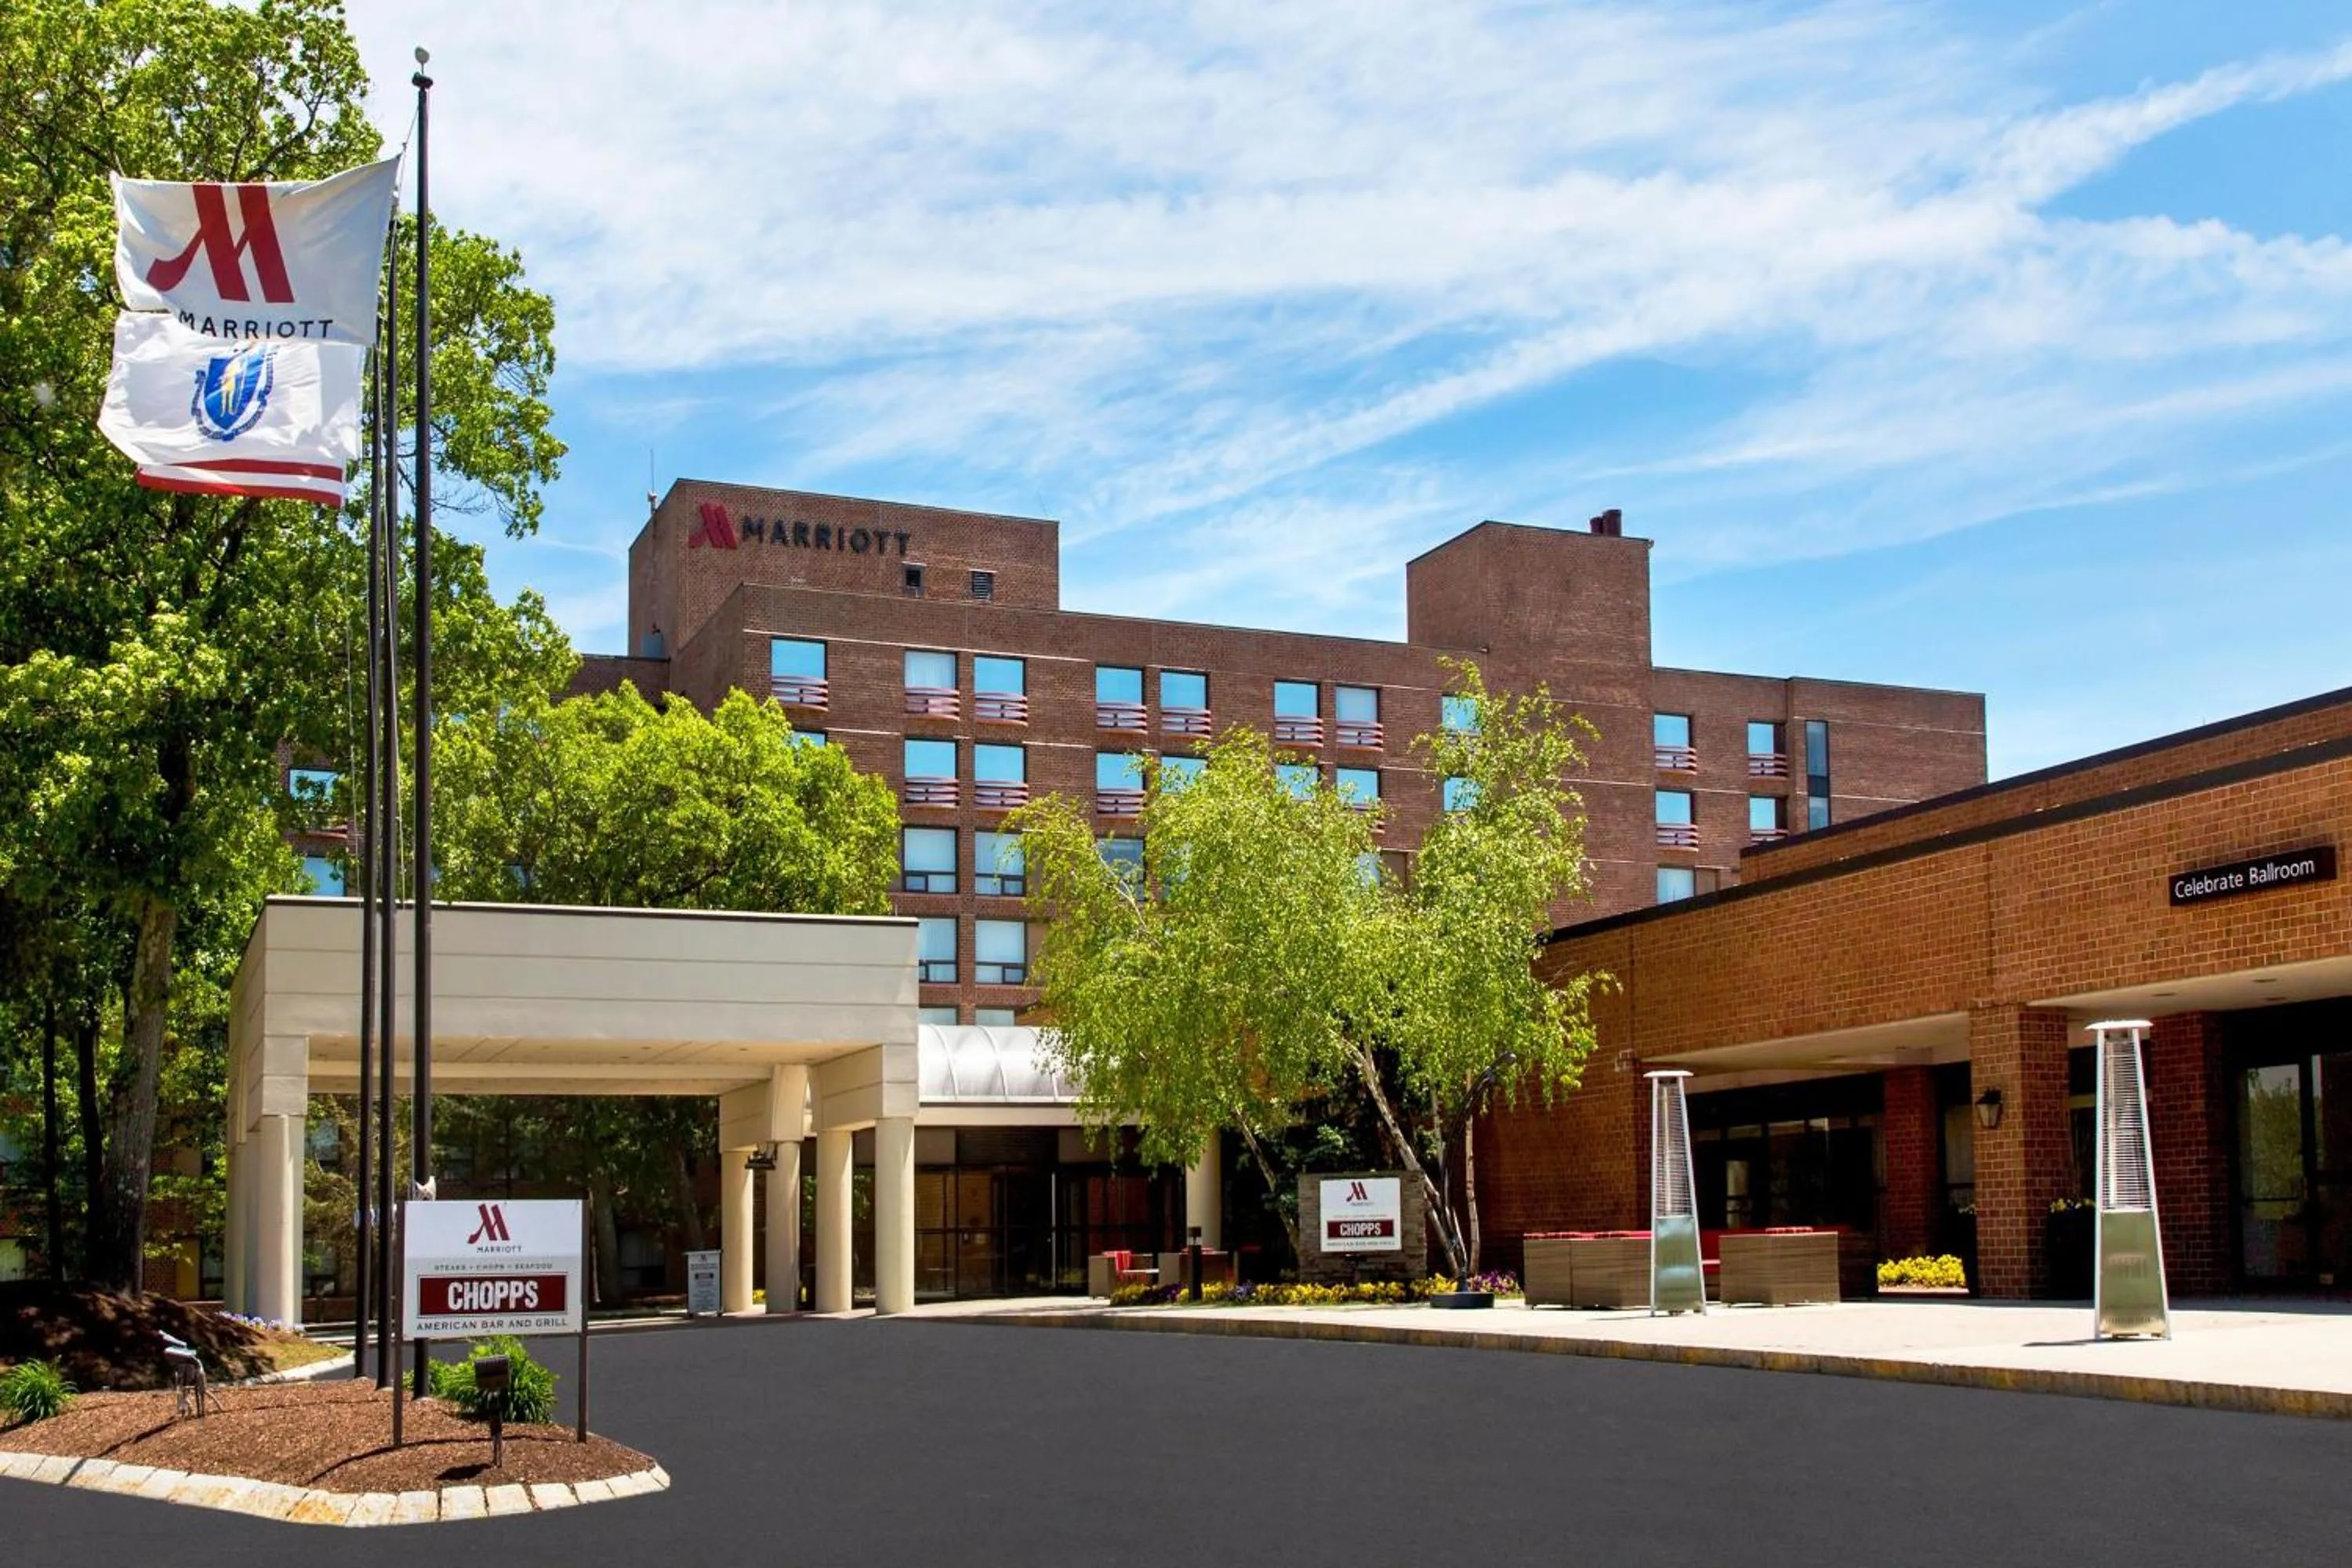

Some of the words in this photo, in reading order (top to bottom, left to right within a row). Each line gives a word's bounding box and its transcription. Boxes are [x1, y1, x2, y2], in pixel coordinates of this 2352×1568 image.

[178, 310, 333, 339] MARRIOTT
[742, 514, 910, 555] MARRIOTT
[2174, 874, 2244, 898] Celebrate
[2249, 859, 2315, 885] Ballroom
[1339, 1222, 1382, 1236] CHOPPS
[476, 1245, 523, 1254] MARRIOTT
[448, 1280, 539, 1311] CHOPPS
[416, 1321, 477, 1331] AMERICAN
[481, 1319, 504, 1329] BAR
[510, 1319, 532, 1328] AND
[535, 1318, 568, 1327] GRILL
